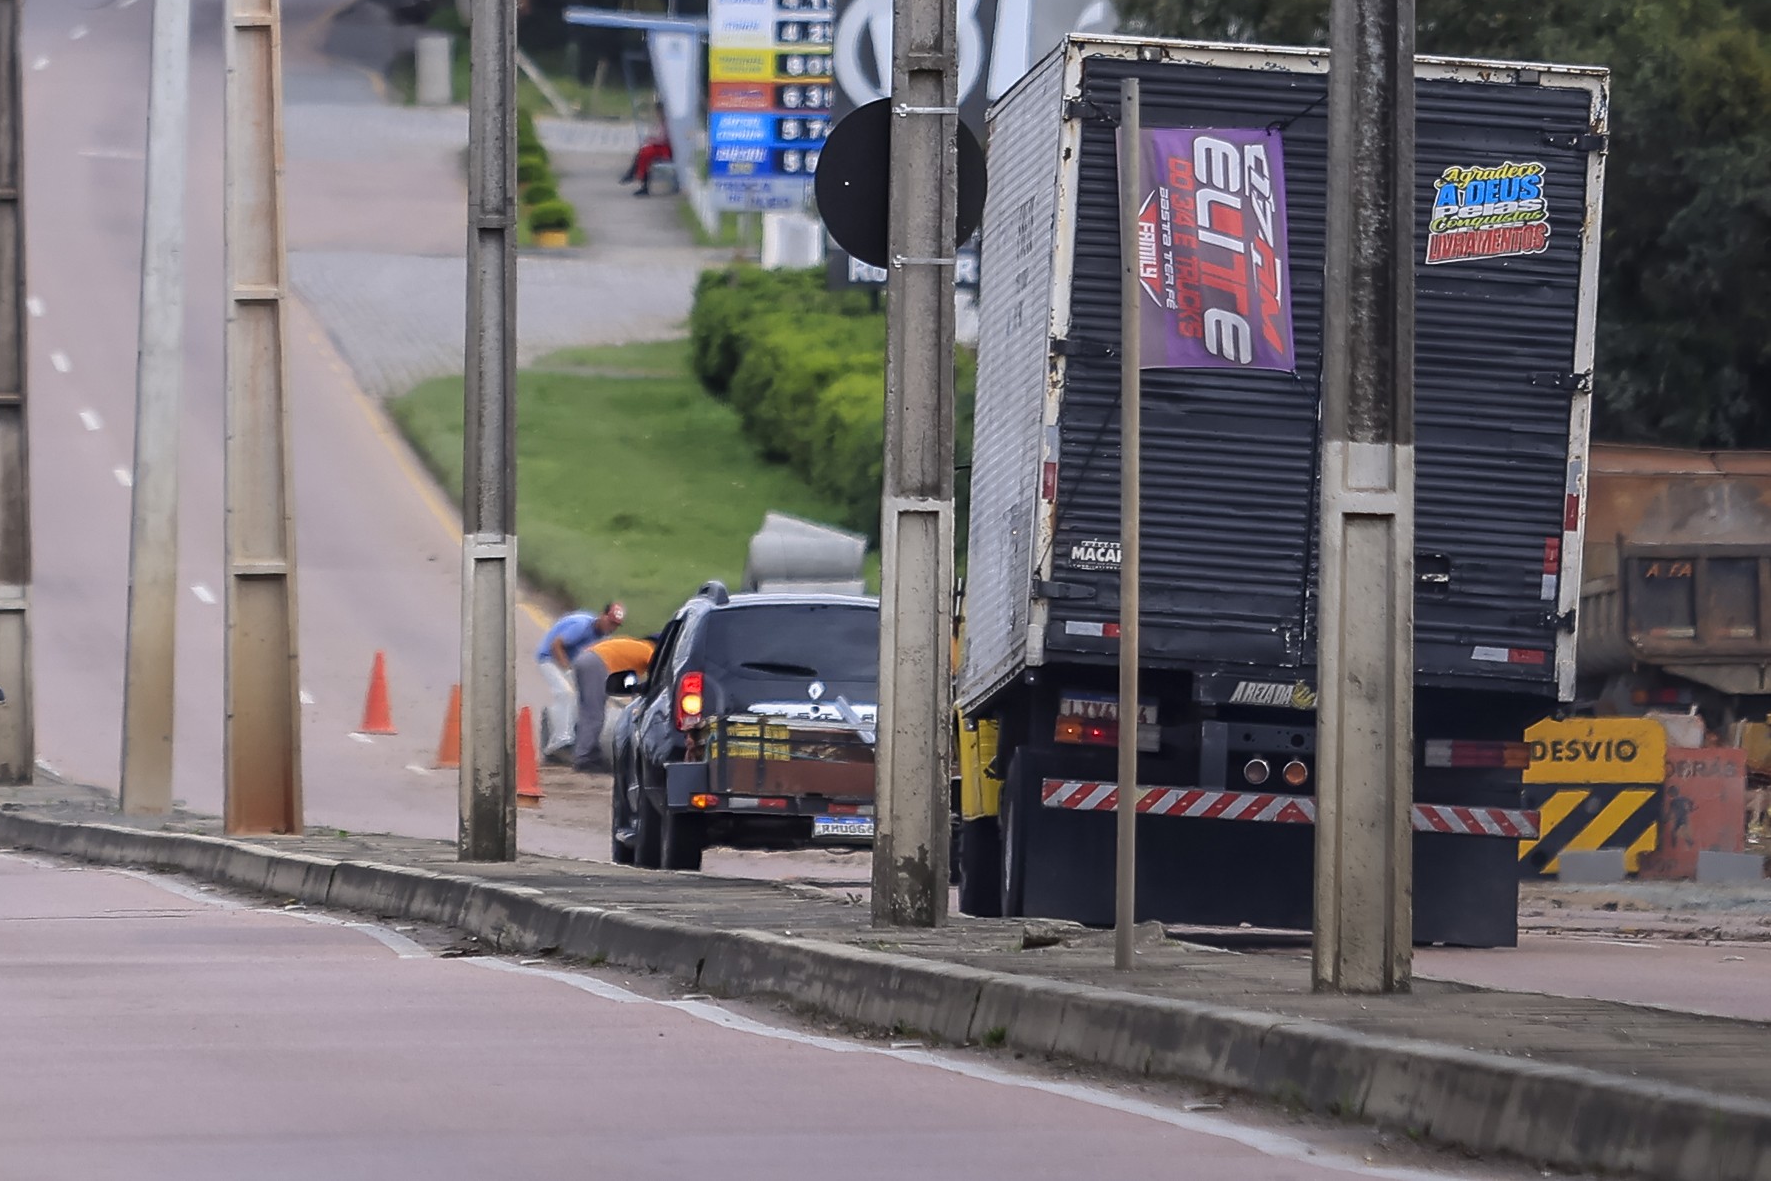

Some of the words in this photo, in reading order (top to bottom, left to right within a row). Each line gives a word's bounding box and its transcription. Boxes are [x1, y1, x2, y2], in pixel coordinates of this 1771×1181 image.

[1168, 157, 1194, 190] DO
[1436, 183, 1458, 207] A
[1465, 175, 1540, 207] DEUS
[1431, 210, 1544, 233] Conquistas
[1138, 221, 1157, 279] FAMILY
[1173, 232, 1198, 250] E
[1429, 223, 1547, 260] LIVRAMENTOS
[1163, 250, 1175, 284] TER
[1530, 739, 1638, 763] DESVIO
